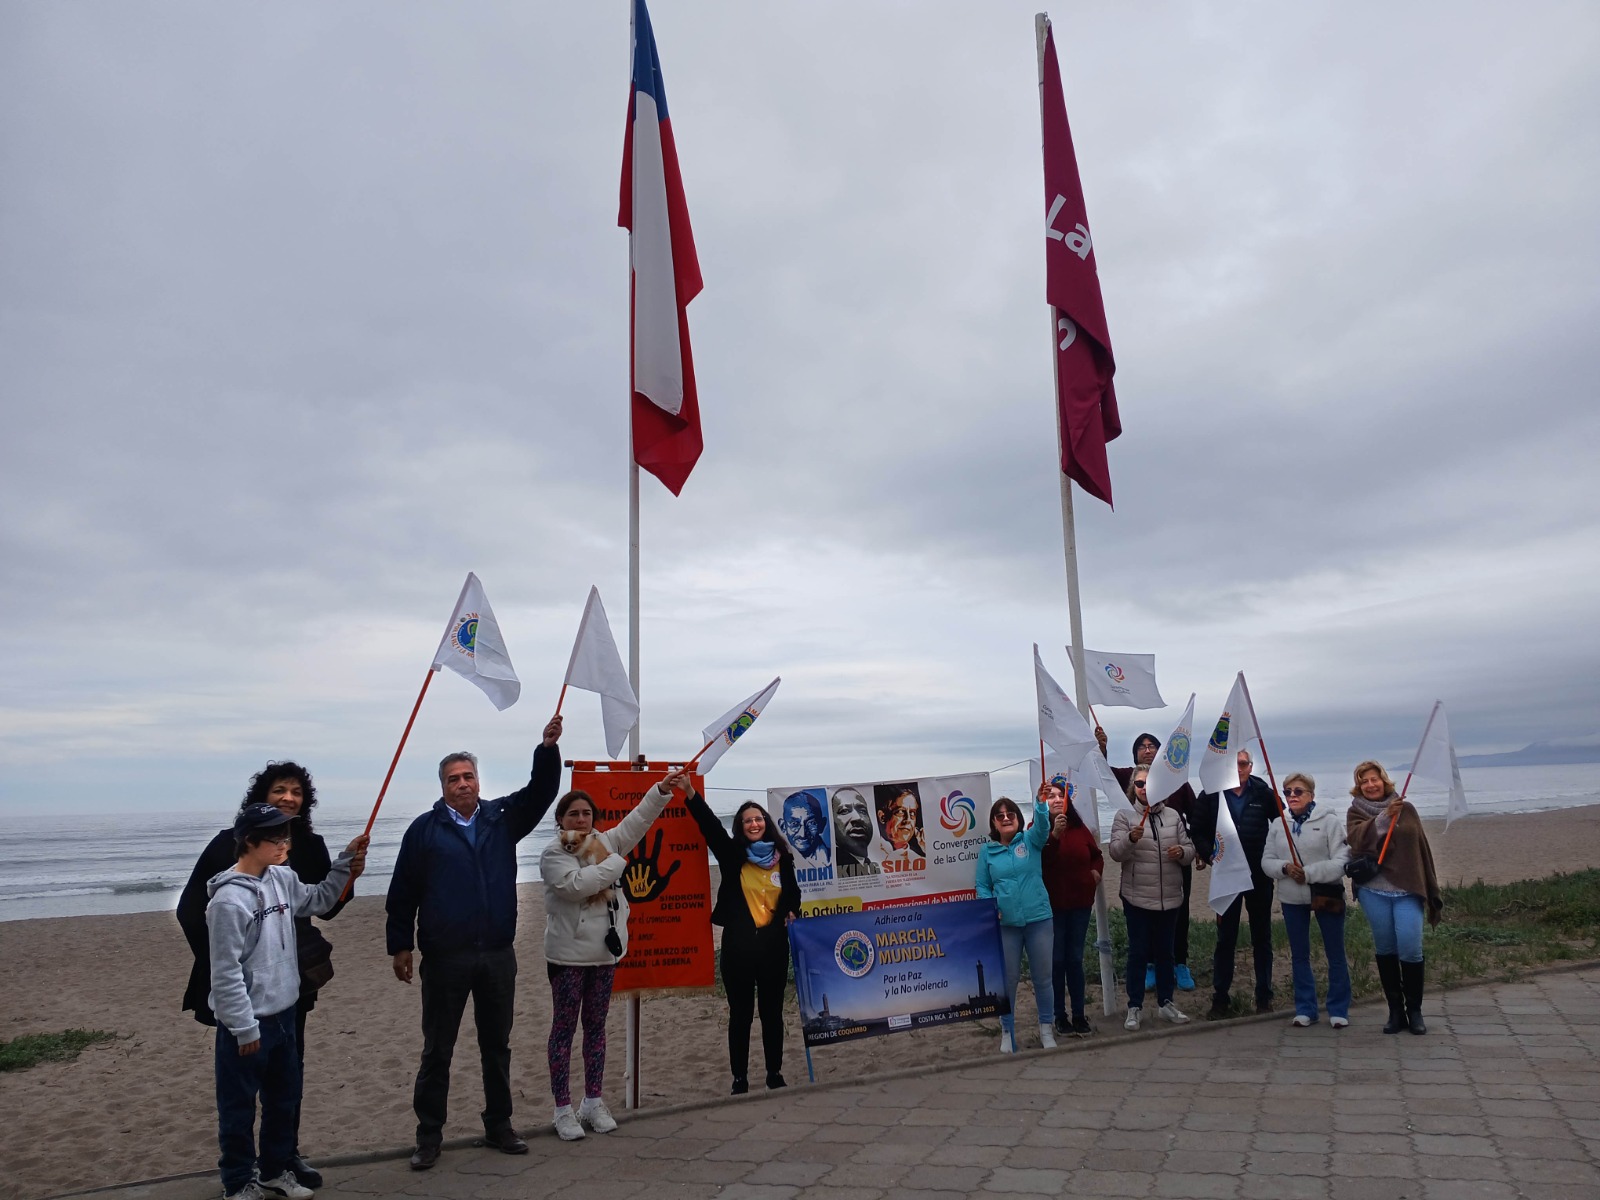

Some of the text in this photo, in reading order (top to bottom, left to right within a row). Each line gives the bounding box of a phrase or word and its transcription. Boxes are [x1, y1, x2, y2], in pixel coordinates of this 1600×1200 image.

[1046, 193, 1092, 261] La
[669, 843, 699, 852] TDAH
[932, 834, 987, 850] Convergencia
[881, 858, 926, 873] SILO
[933, 855, 944, 865] de
[946, 854, 956, 864] las
[837, 861, 882, 878] KING
[661, 902, 704, 910] DE DOWN
[812, 903, 854, 918] Octubre
[875, 914, 906, 926] Adhiero
[914, 912, 922, 921] la
[876, 927, 937, 947] MARCHA
[644, 948, 652, 956] DE
[653, 947, 679, 956] MARZO
[879, 943, 945, 965] MUNDIAL
[883, 971, 922, 984] Por la Paz
[884, 978, 949, 999] y la No violencia
[918, 1014, 934, 1024] COSTA
[829, 1030, 838, 1038] DE
